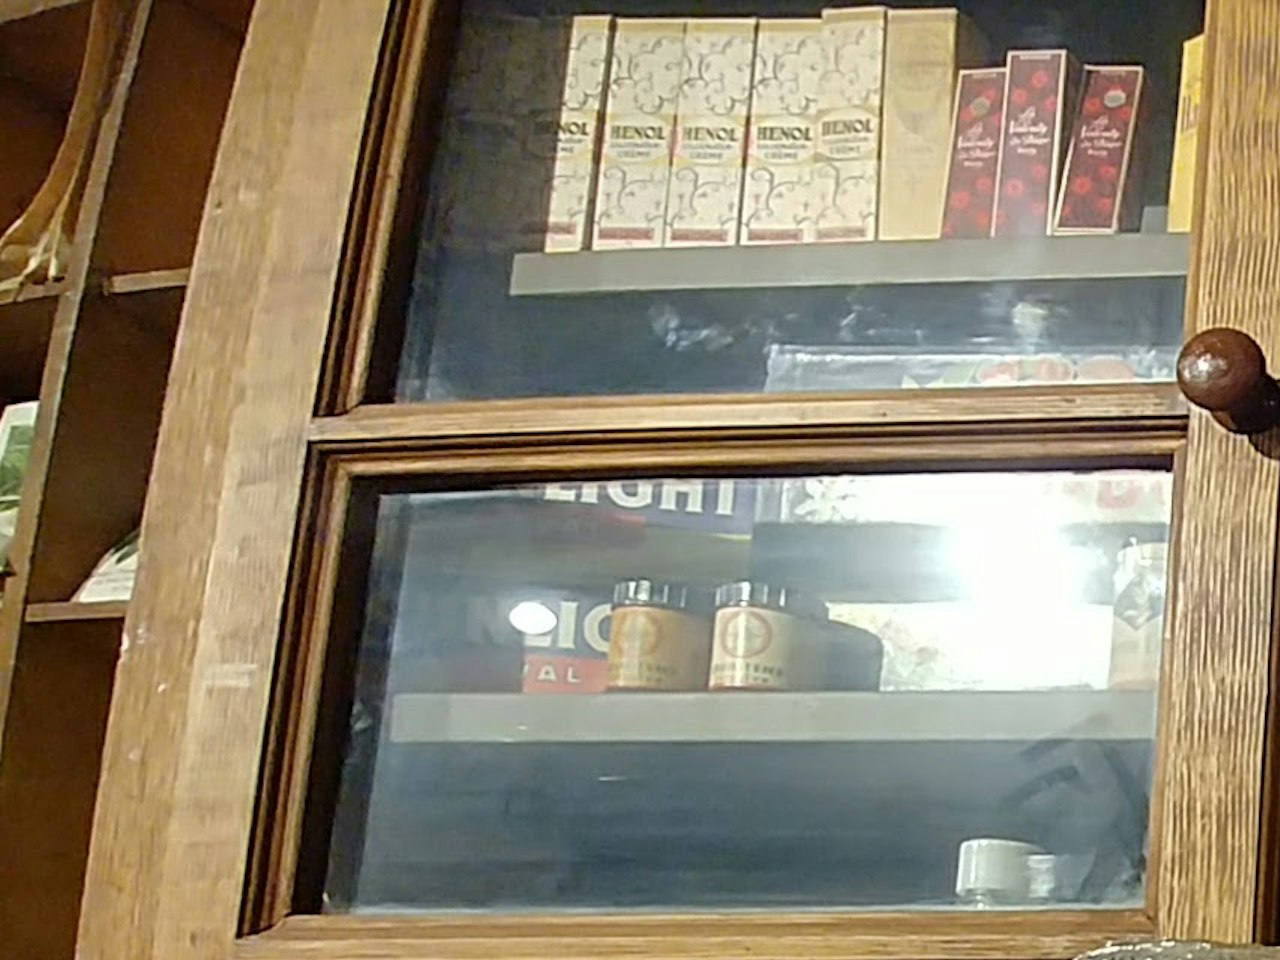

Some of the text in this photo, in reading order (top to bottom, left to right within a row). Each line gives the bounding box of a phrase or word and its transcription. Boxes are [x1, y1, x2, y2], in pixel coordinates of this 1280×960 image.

[610, 125, 666, 140] HENOL
[683, 127, 738, 142] HENOL
[757, 126, 813, 141] HENOL
[822, 119, 874, 136] HENOL
